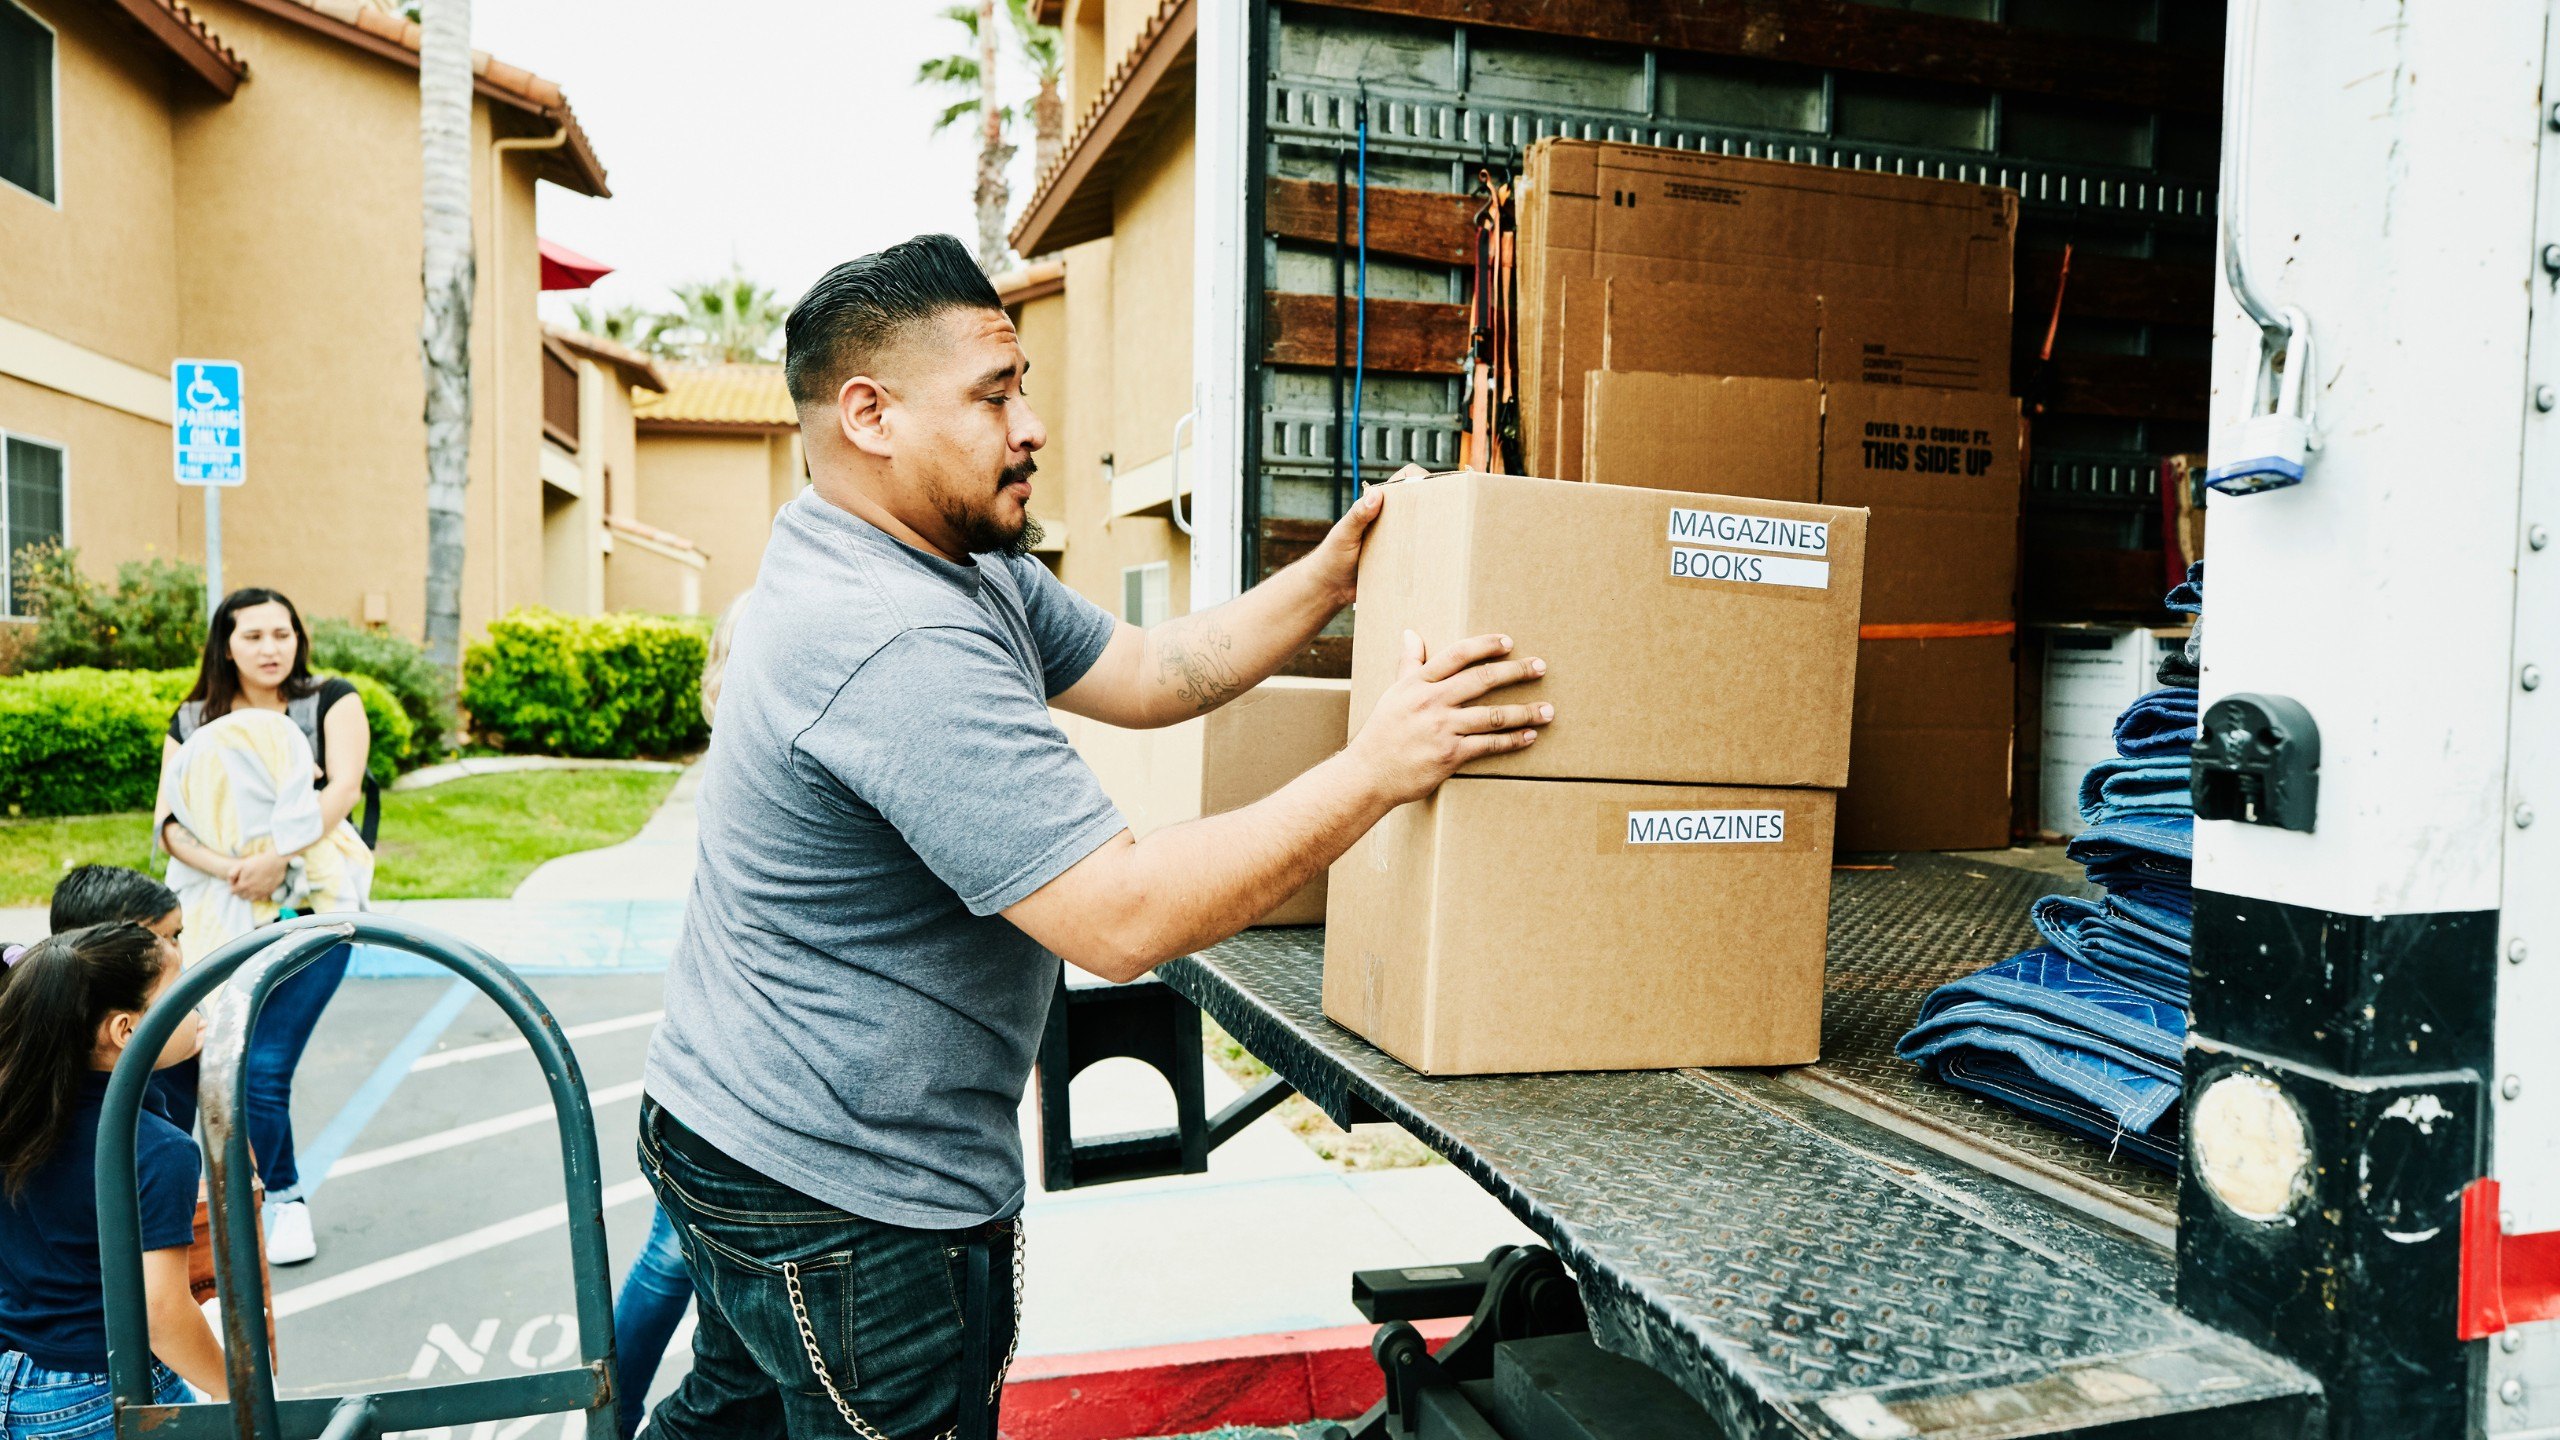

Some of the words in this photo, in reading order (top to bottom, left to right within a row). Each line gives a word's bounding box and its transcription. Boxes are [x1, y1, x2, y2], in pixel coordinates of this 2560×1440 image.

[178, 408, 239, 429] PARKING
[1865, 421, 1900, 438] OVER
[1905, 425, 1926, 440] 3.0
[1930, 426, 1969, 443] CUBIC
[1973, 430, 1991, 445] FT.
[190, 427, 228, 446] ONLY
[1862, 440, 1909, 471] THIS
[1914, 444, 1961, 475] SIDE
[1965, 448, 1993, 476] UP
[1672, 510, 1826, 550] MAGAZINES
[1673, 551, 1762, 582] BOOKS
[1630, 815, 1782, 842] MAGAZINES
[407, 1313, 579, 1380] NO
